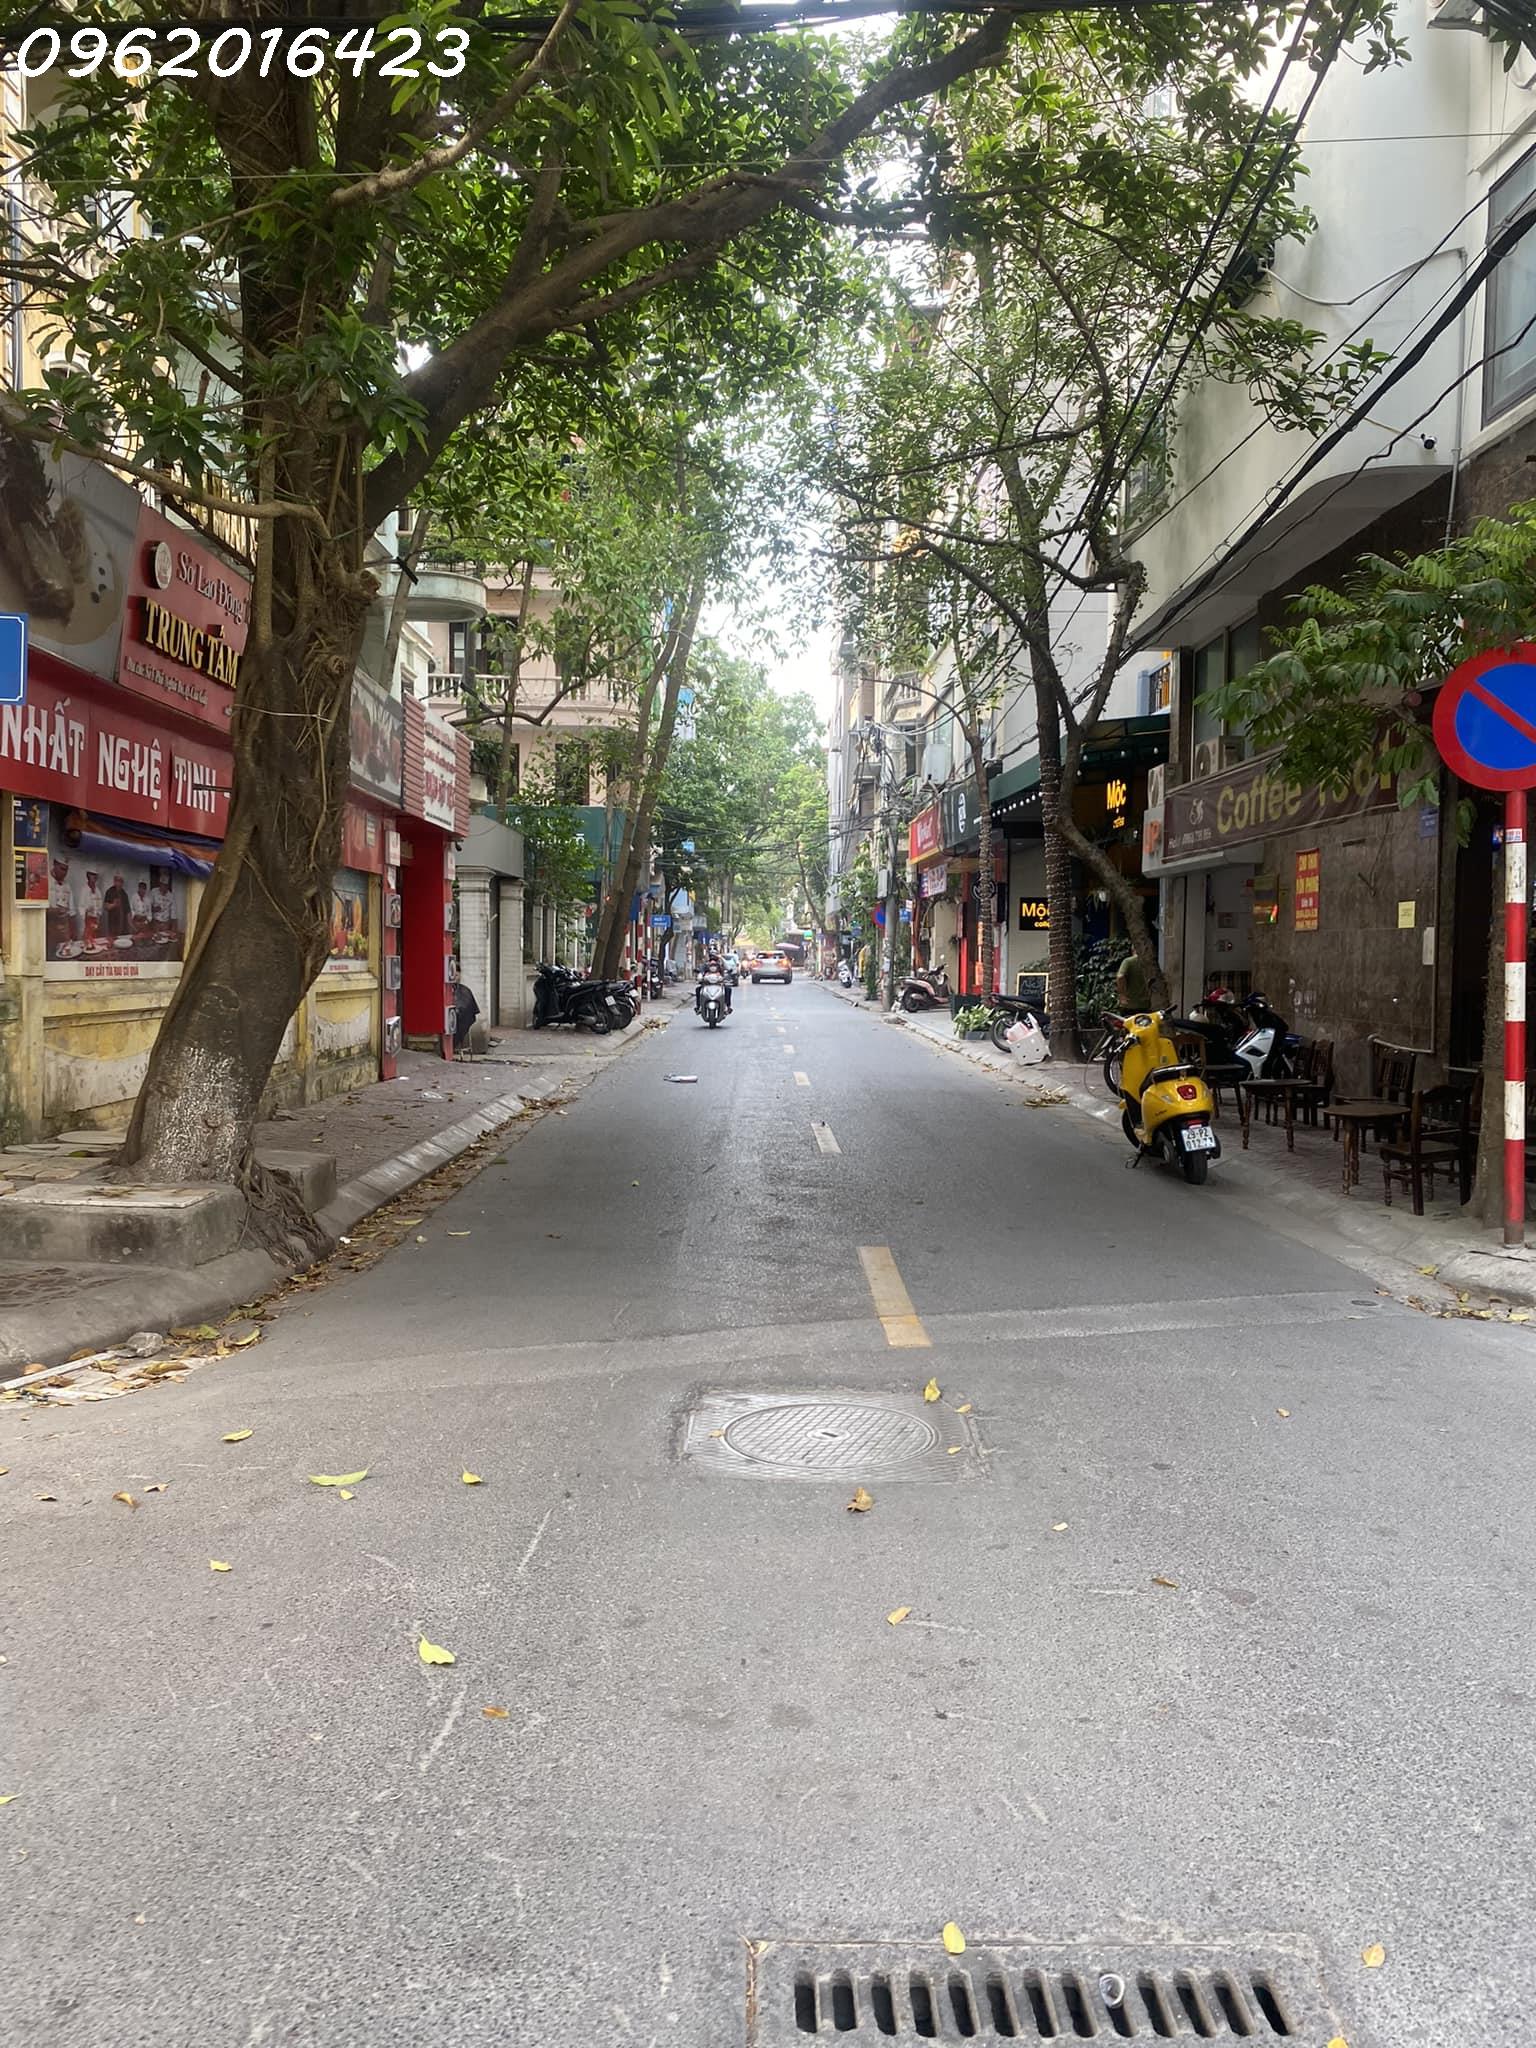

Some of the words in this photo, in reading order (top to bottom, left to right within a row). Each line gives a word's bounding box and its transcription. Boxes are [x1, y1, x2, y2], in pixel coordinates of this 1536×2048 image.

[197, 564, 216, 600] Lao
[219, 581, 244, 625] Động
[145, 596, 204, 670] TRUNG
[206, 625, 240, 689] TÂM
[0, 697, 85, 777] NHẤT
[98, 738, 162, 811] NGHỆ
[1106, 778, 1127, 814] Mộc
[1216, 773, 1301, 834] Coffee
[1022, 902, 1050, 920] Mộ
